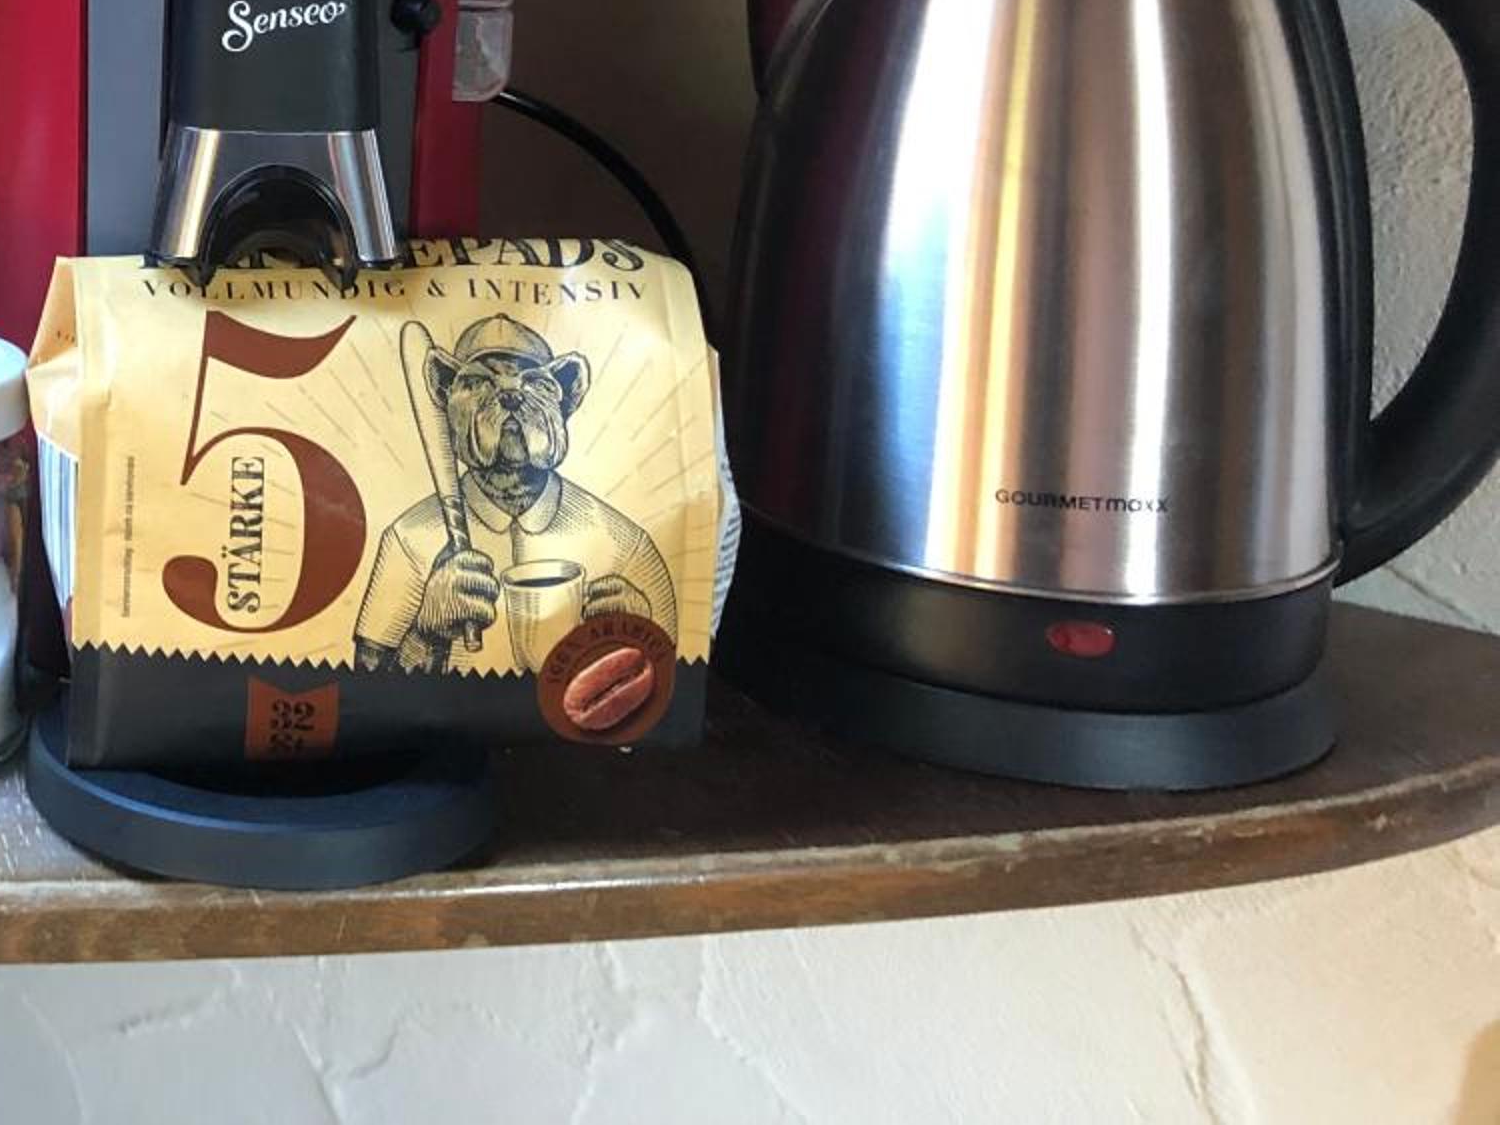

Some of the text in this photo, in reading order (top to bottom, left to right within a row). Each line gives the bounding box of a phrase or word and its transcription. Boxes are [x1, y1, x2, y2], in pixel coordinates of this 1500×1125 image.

[220, 0, 348, 53] Senseo
[427, 278, 446, 297] &
[468, 277, 646, 305] INTENSIV
[161, 309, 367, 634] 5
[226, 455, 265, 615] STÄRKE
[269, 699, 316, 732] 32
